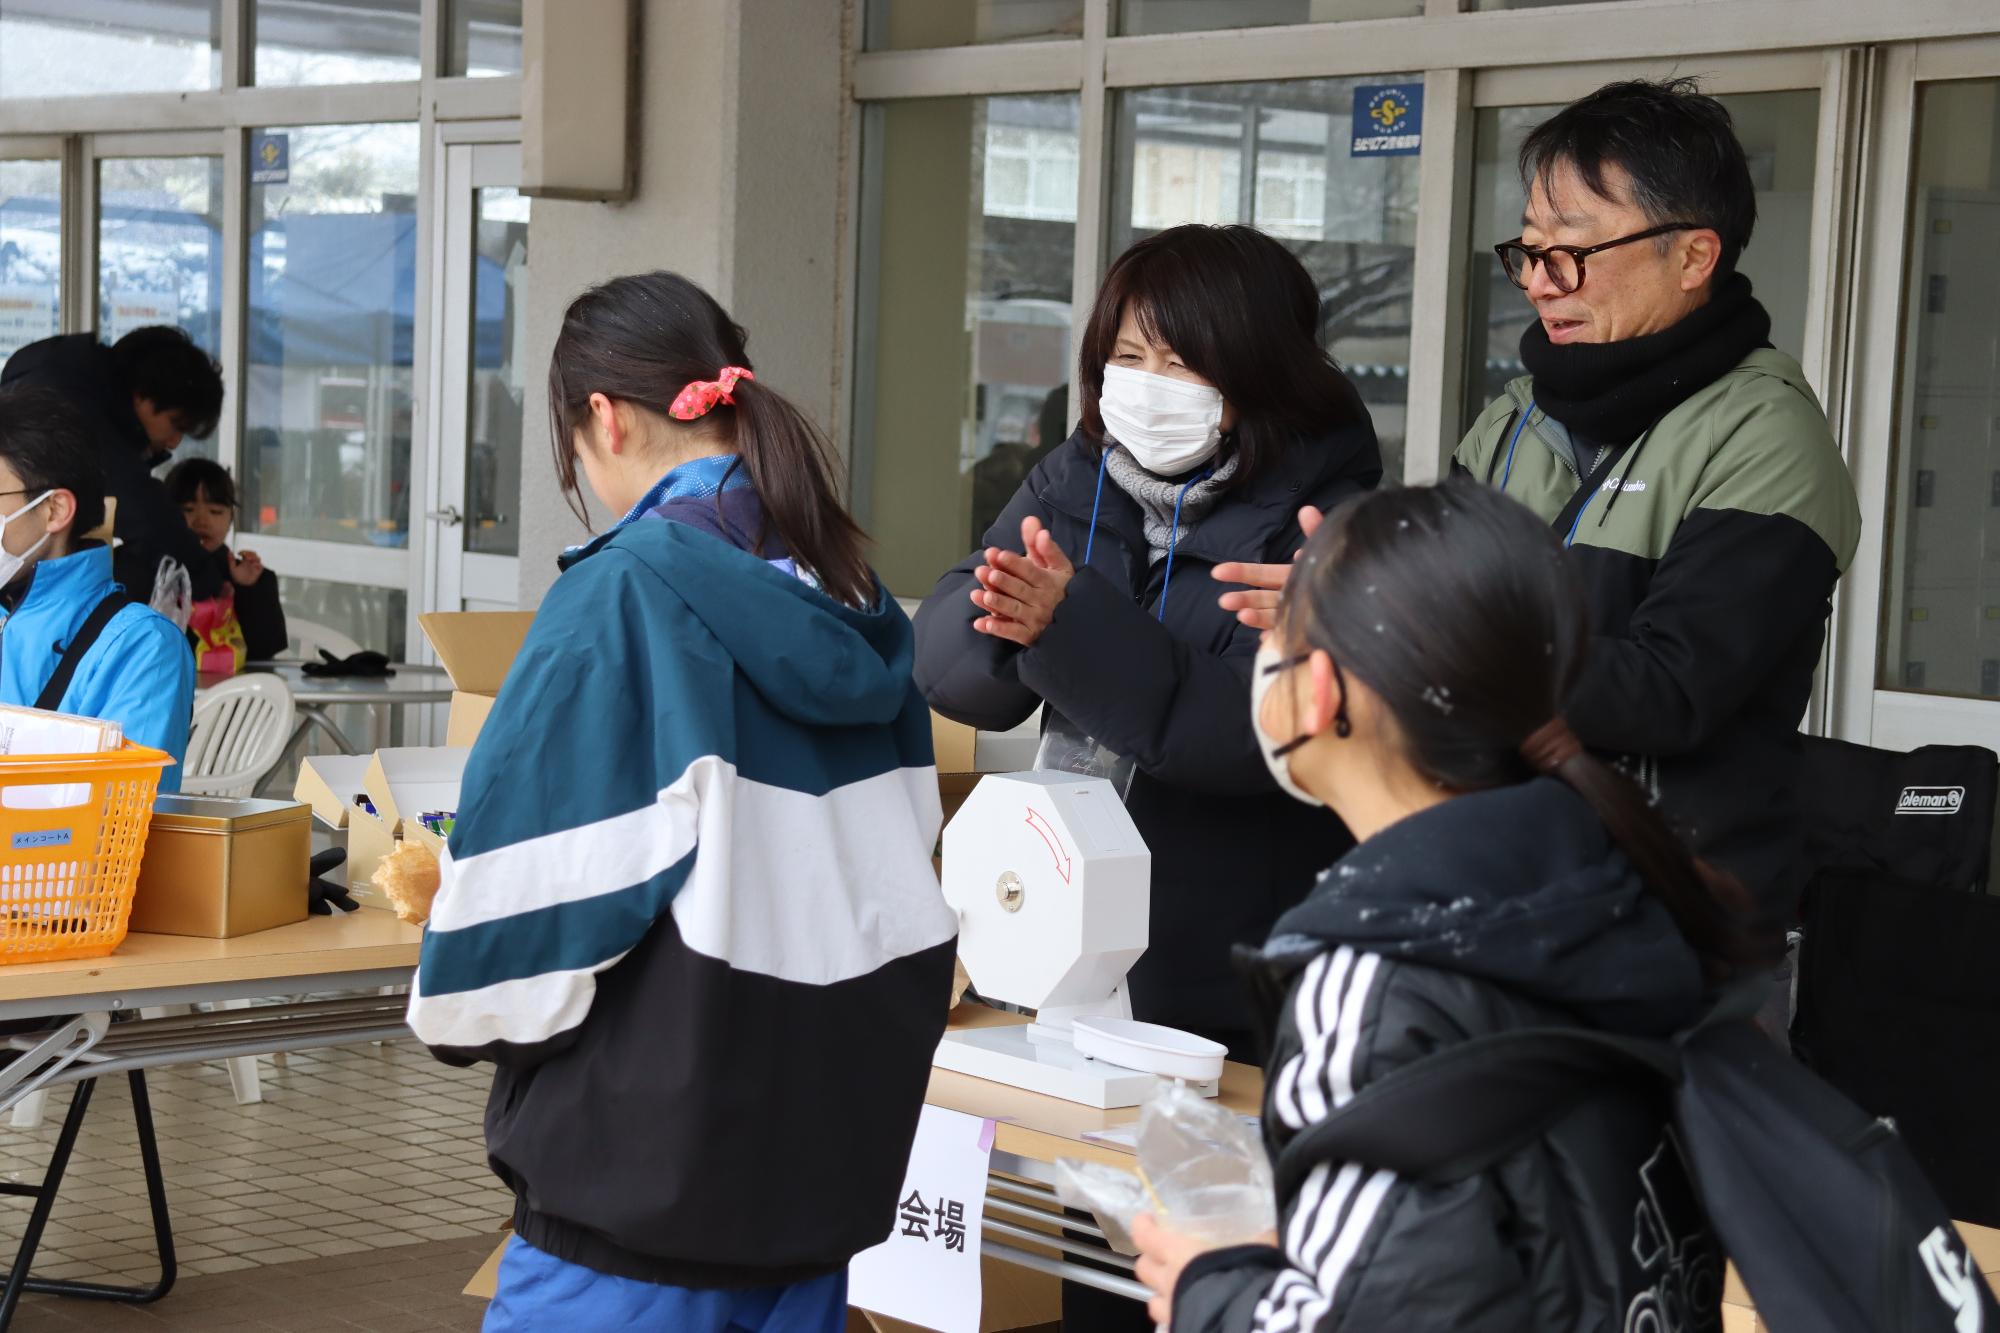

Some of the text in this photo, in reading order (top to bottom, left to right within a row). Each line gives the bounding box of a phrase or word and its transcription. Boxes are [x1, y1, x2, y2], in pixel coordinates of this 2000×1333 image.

[16, 832, 70, 844] メインコートA
